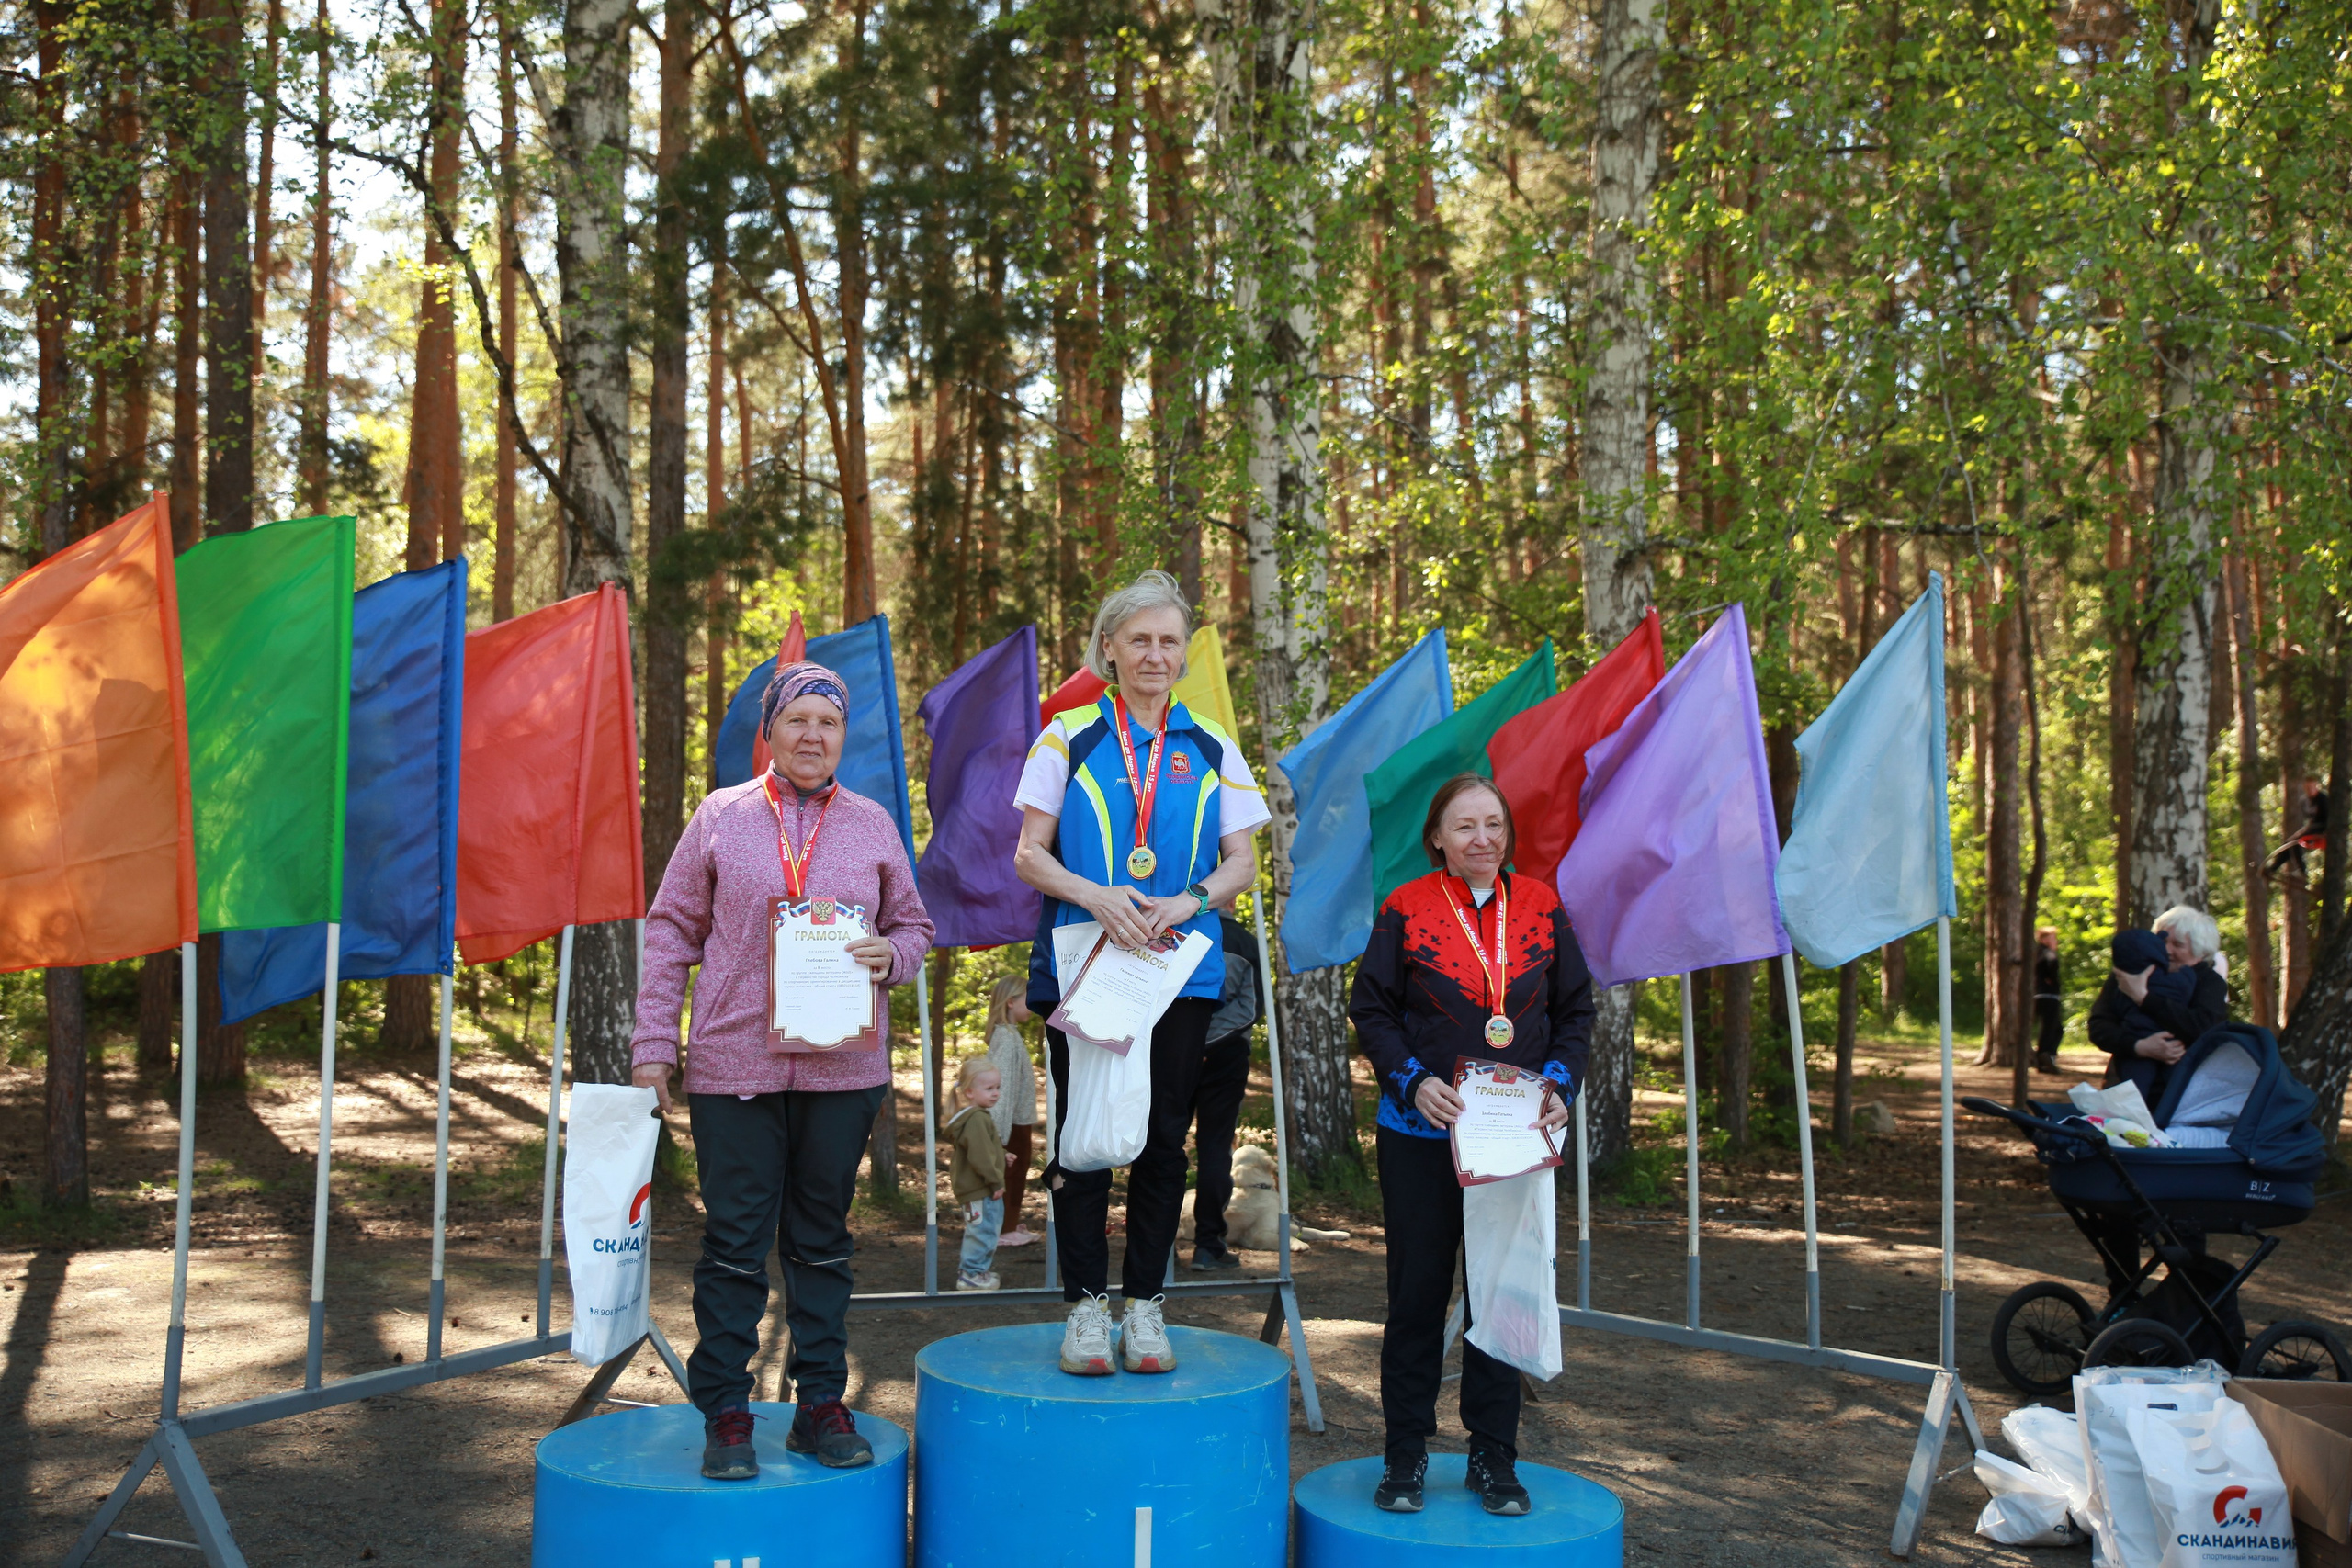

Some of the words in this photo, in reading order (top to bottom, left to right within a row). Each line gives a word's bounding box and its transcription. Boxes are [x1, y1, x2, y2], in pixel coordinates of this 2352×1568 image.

[795, 931, 851, 941] ГРАМОТА
[1127, 948, 1170, 971] АМОТА
[1475, 1086, 1526, 1098] ГРАМОТА
[593, 1232, 645, 1253] СКАНД
[2202, 1552, 2246, 1561] спортивный
